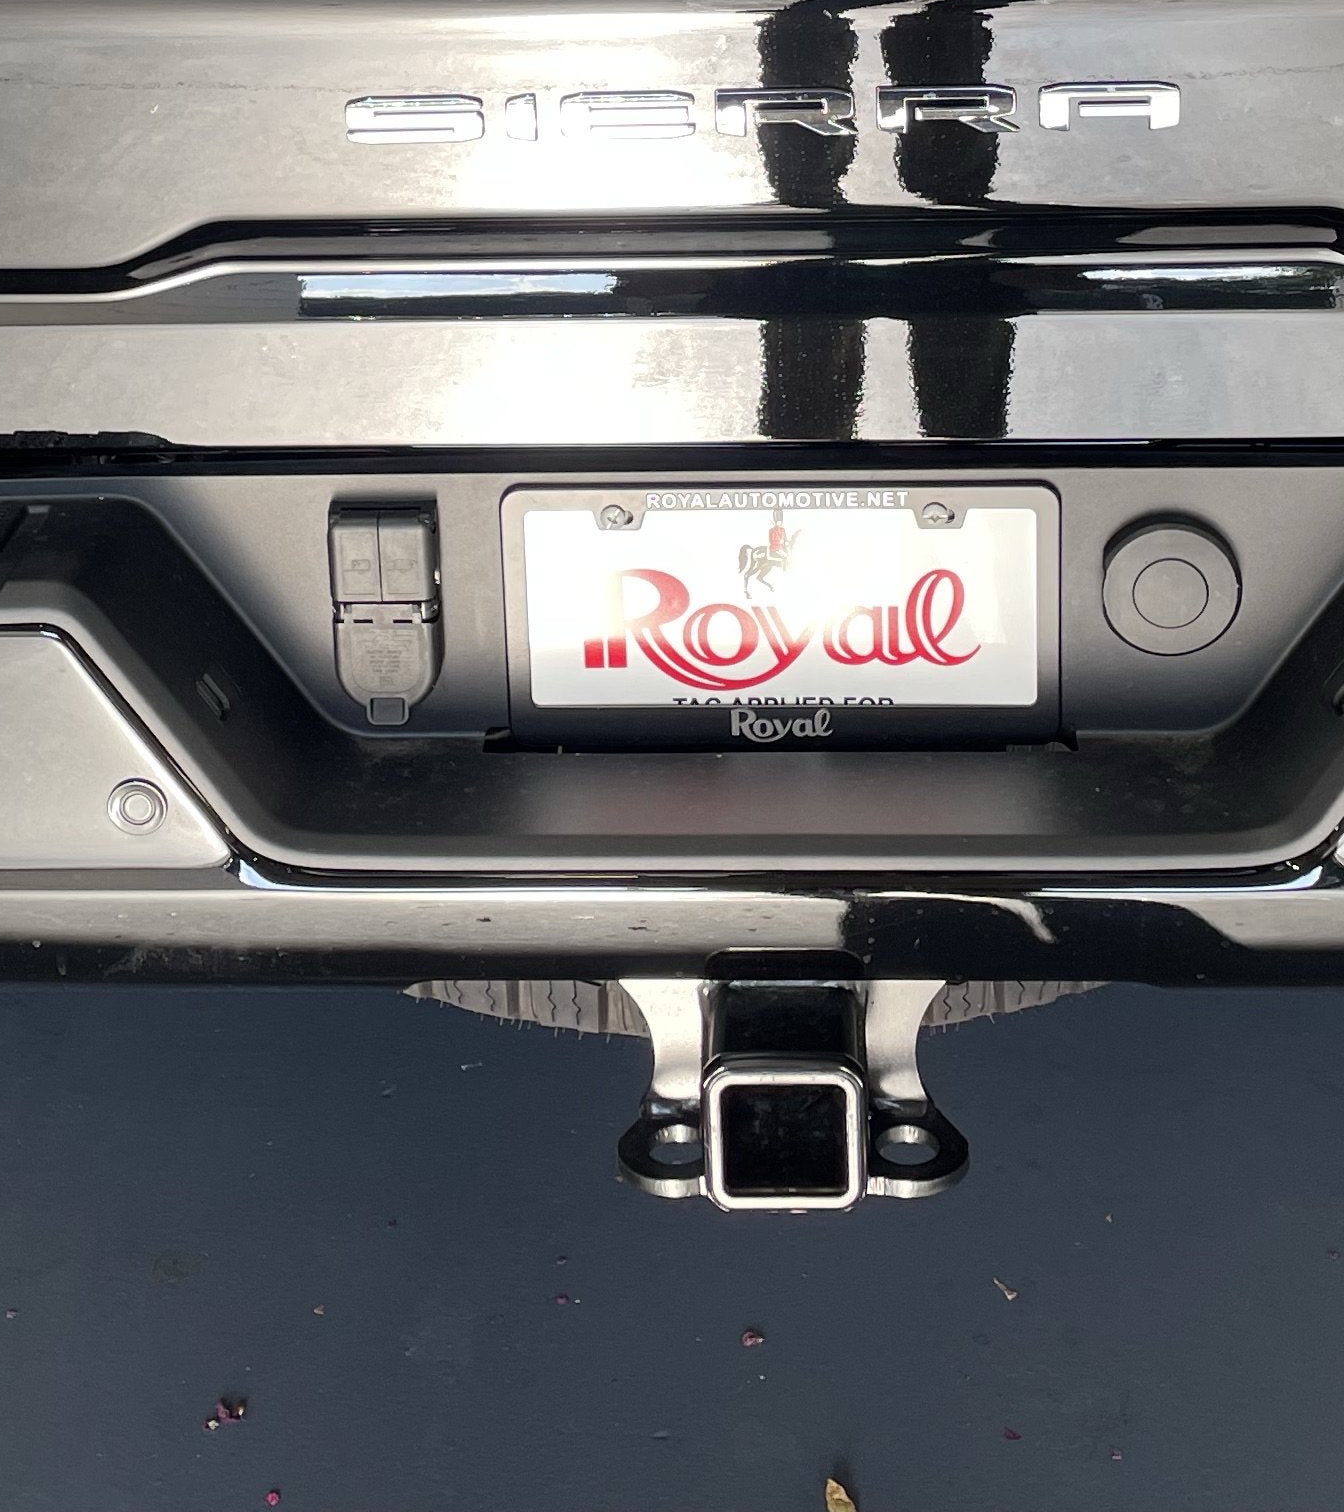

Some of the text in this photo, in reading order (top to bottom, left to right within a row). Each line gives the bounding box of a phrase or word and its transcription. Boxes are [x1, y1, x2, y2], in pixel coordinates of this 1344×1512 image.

[344, 81, 1182, 145] SIERRA
[645, 491, 909, 509] ROYALAUTOMOTIVE.NET
[583, 568, 983, 691] Royal
[730, 708, 833, 742] Royal
